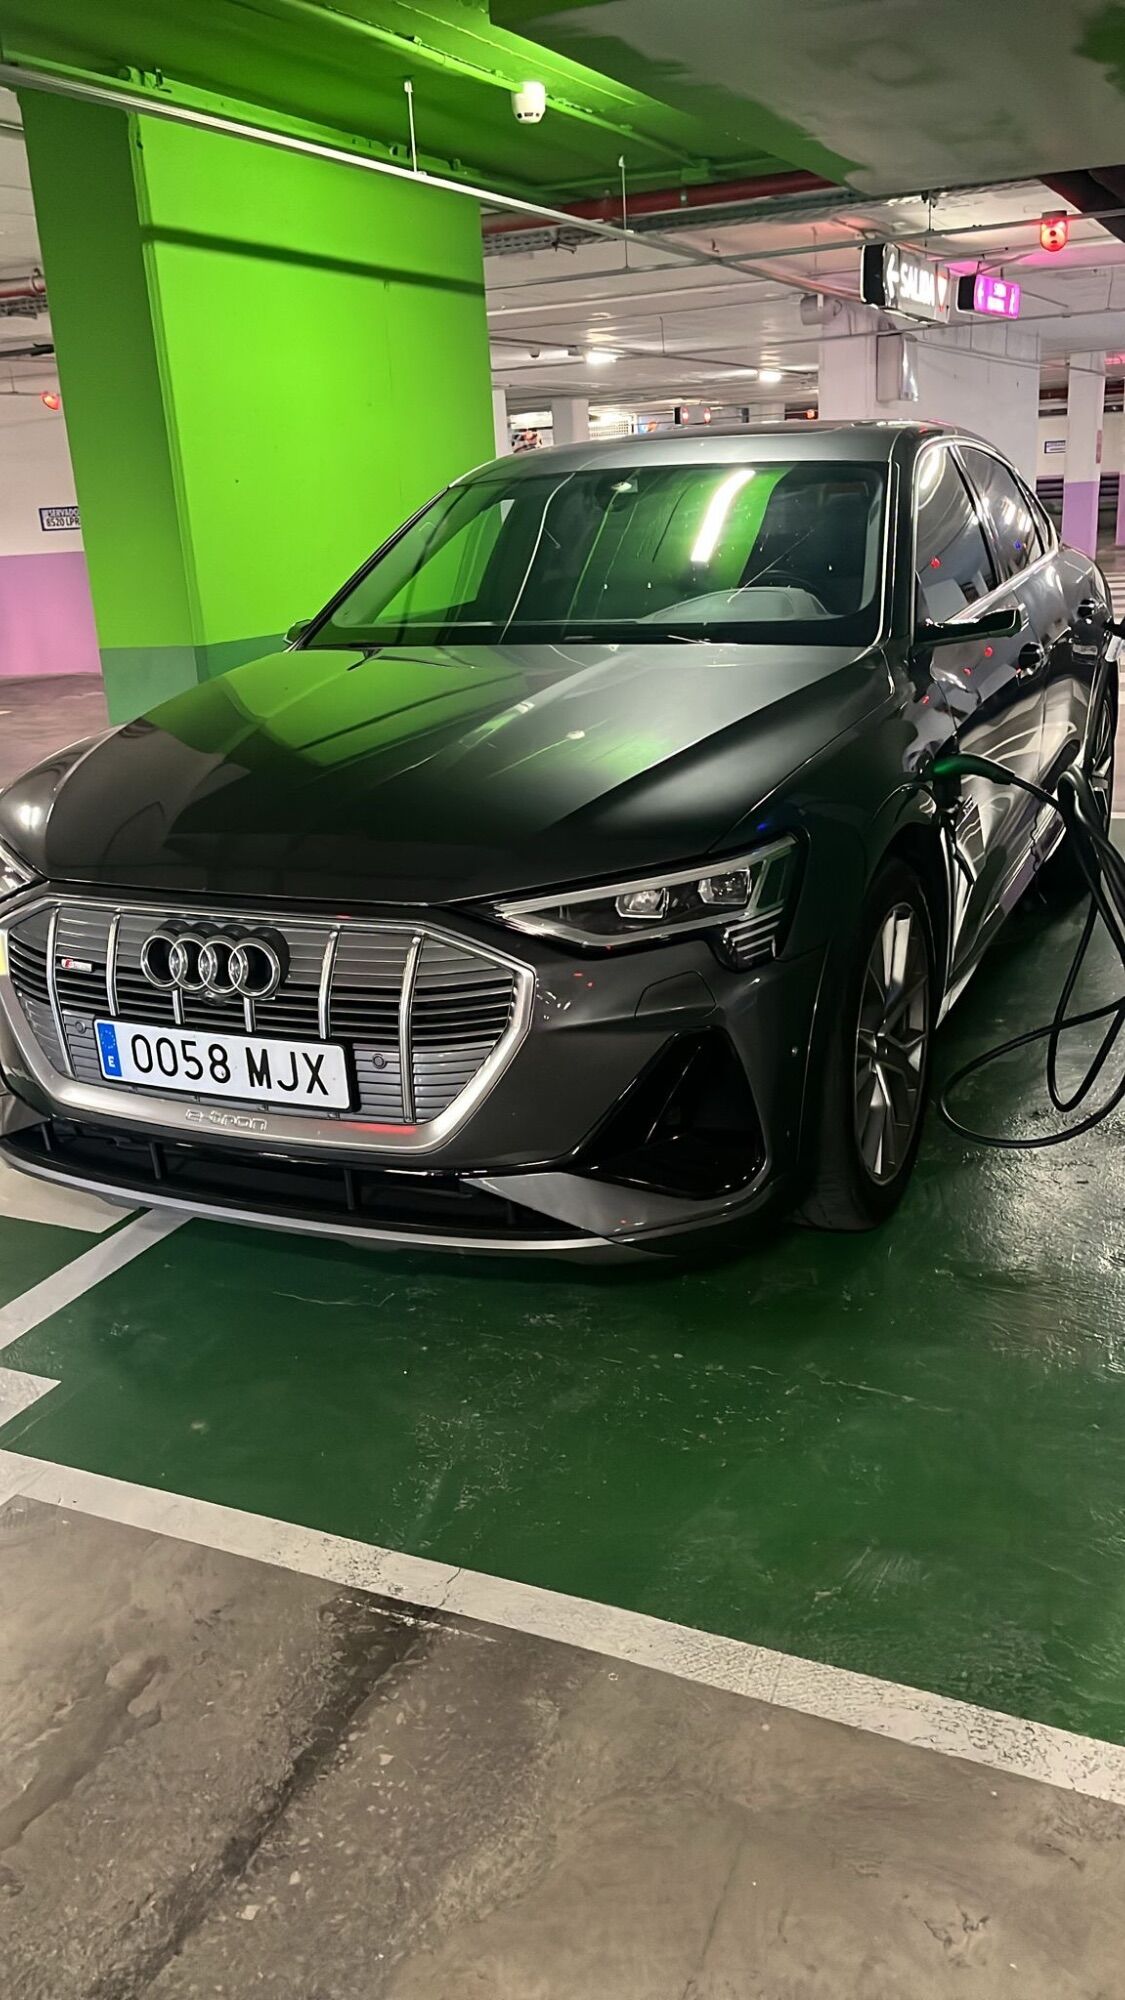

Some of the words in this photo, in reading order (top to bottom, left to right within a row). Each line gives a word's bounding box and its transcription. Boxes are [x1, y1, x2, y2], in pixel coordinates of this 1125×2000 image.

[900, 263, 935, 307] SALIDA
[108, 1056, 116, 1068] E
[131, 1033, 231, 1084] 0058
[245, 1046, 329, 1096] MJX
